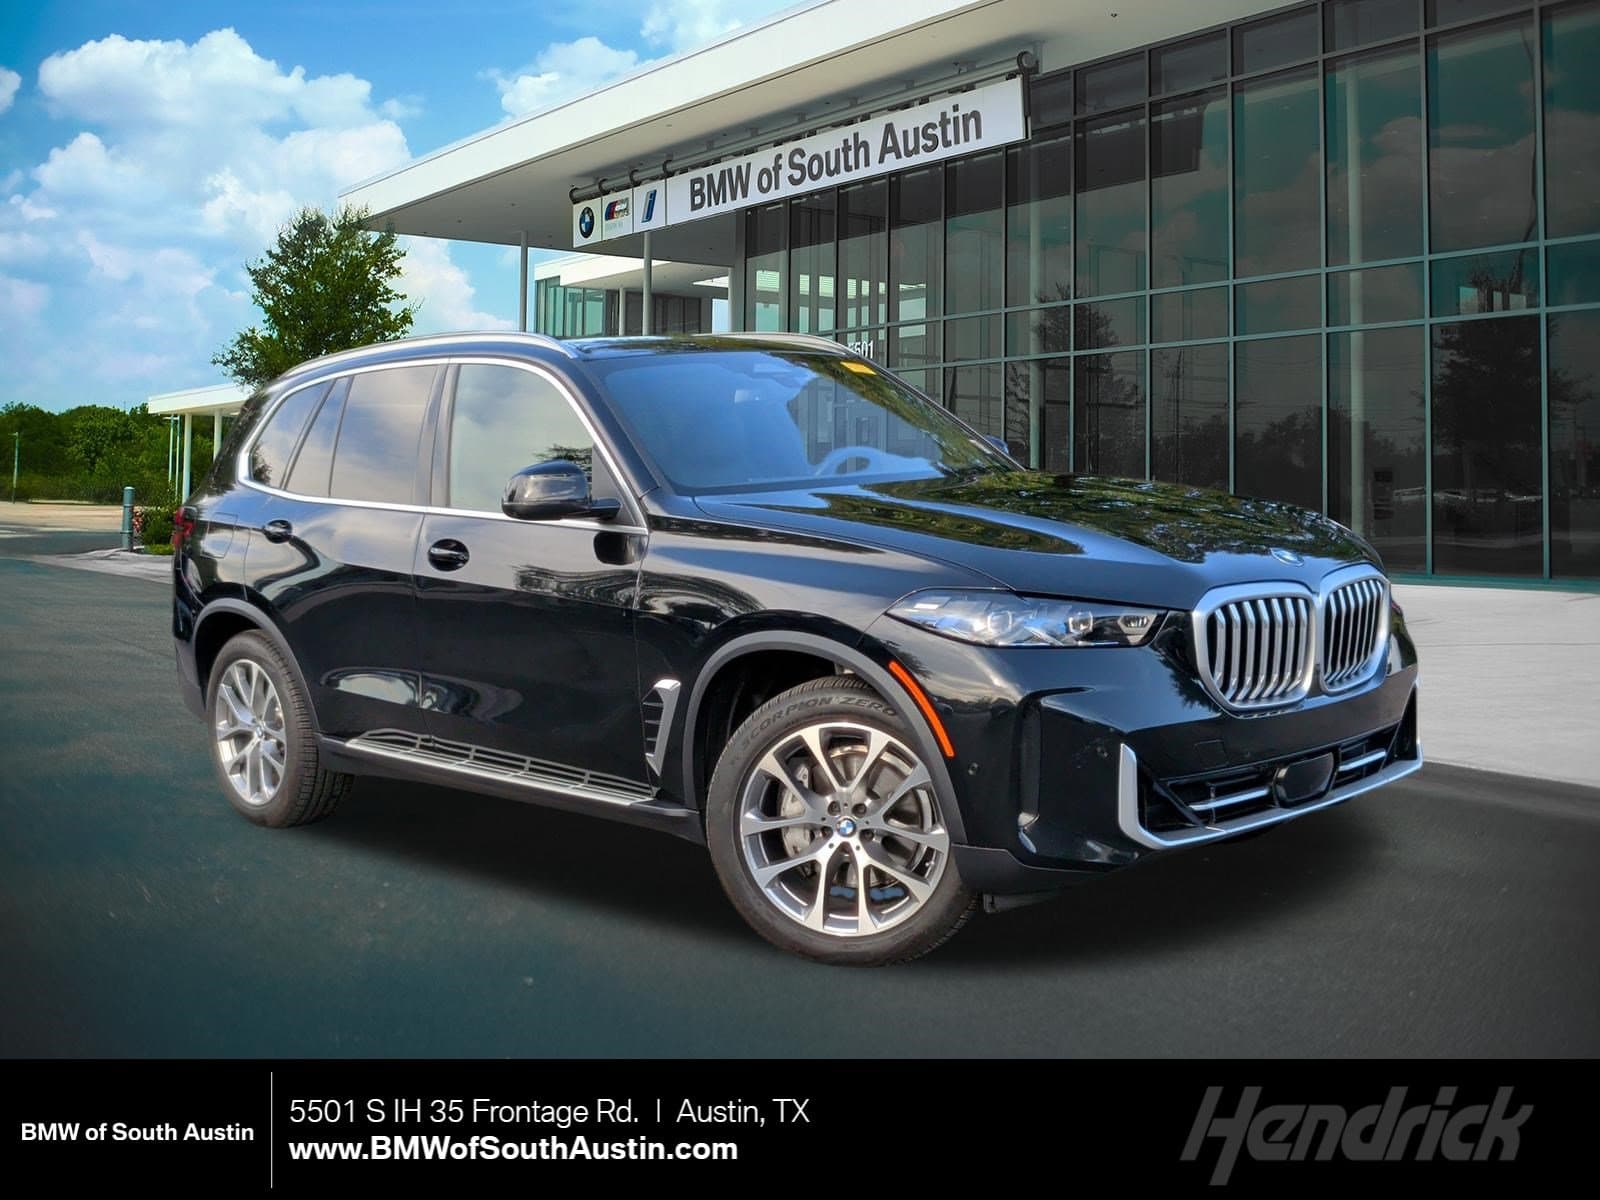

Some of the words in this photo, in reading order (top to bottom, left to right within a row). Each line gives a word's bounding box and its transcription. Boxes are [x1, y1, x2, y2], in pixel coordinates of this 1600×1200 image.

[689, 162, 752, 212] BMW
[756, 152, 783, 195] of
[787, 131, 871, 187] South
[877, 103, 983, 165] Austin
[838, 696, 898, 717] ZERO
